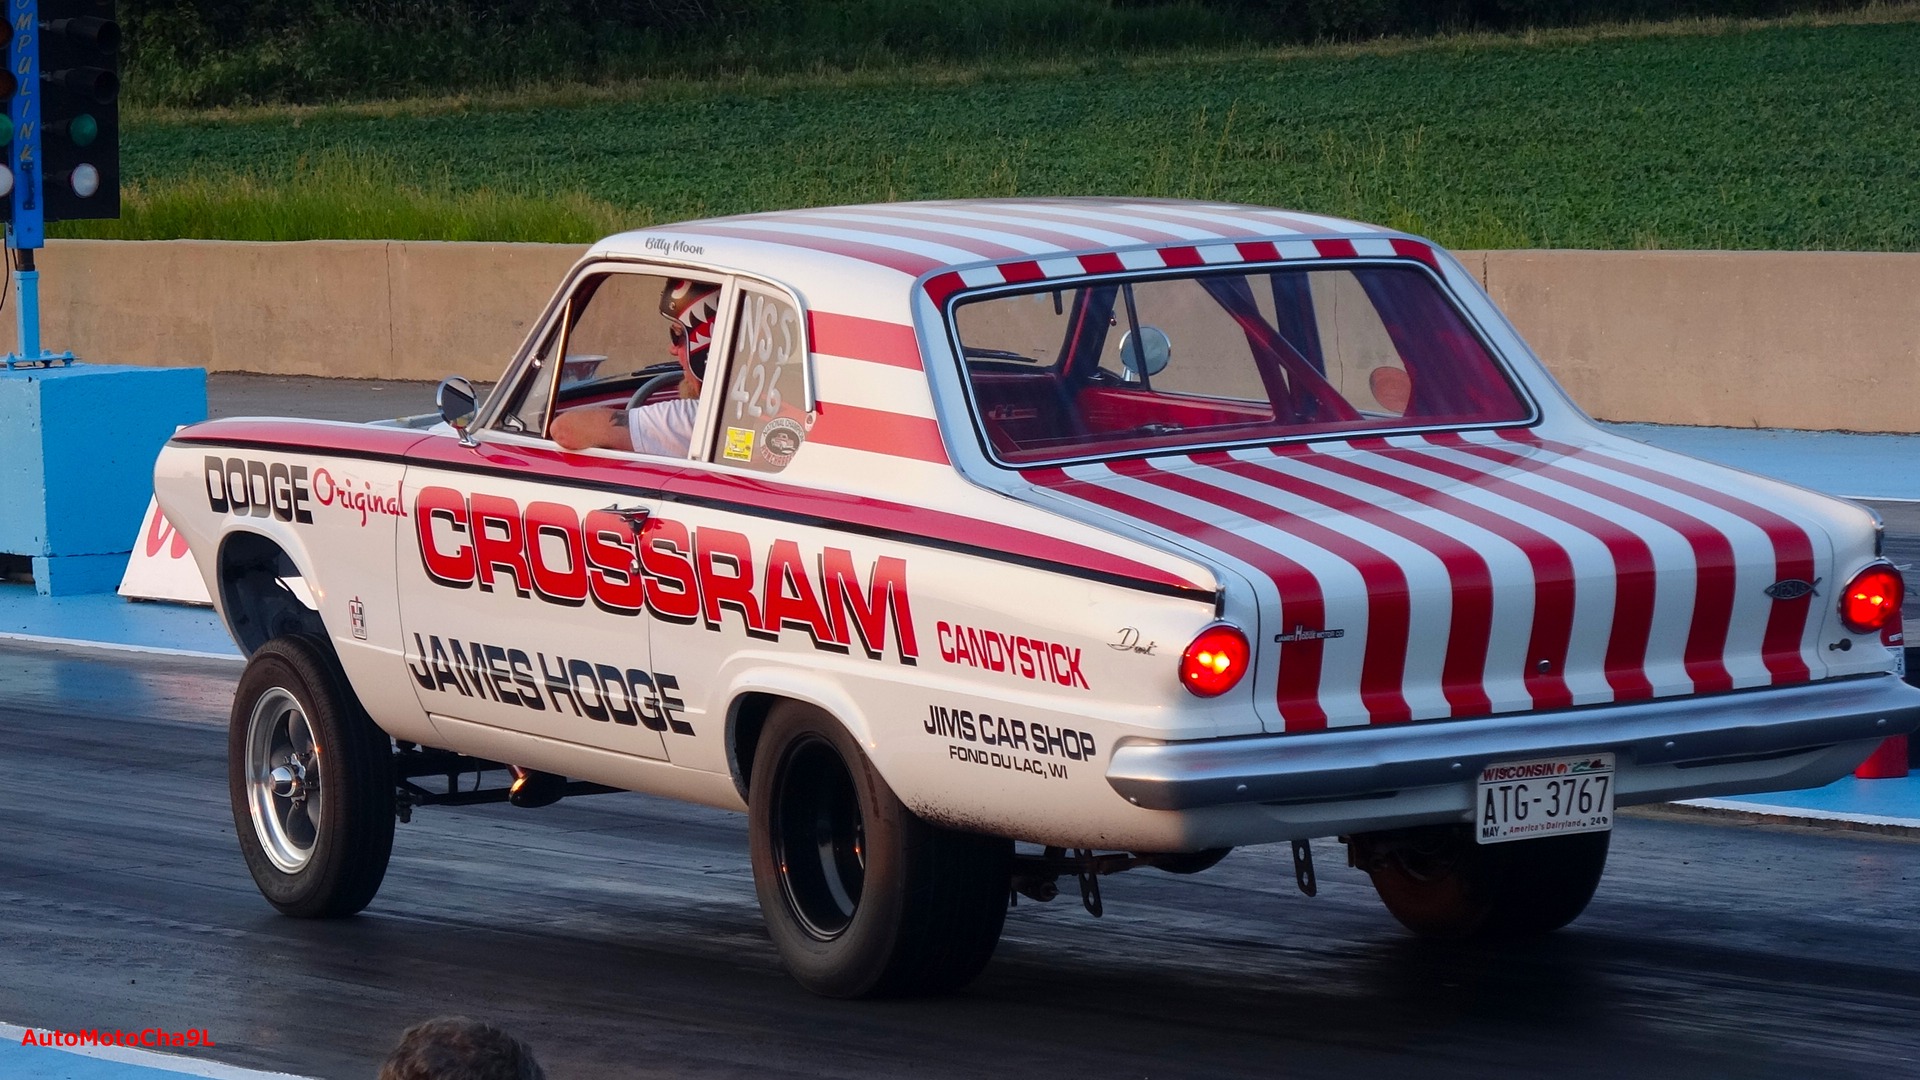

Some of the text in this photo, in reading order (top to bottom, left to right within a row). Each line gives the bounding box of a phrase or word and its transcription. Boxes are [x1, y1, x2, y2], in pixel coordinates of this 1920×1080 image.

[645, 237, 704, 256] Billy Moon
[739, 295, 797, 365] NSS
[731, 364, 781, 420] 426
[204, 455, 314, 525] DODGE
[313, 467, 408, 527] Original
[414, 485, 919, 667] CROSSRAM
[936, 620, 1090, 690] CANDYSTICK
[408, 632, 696, 737] JAMES HODGE
[924, 704, 1096, 762] JIMS CAR SHOP
[949, 745, 1068, 779] FOND DU LAC, WI
[1483, 763, 1556, 782] WISCONSIN
[1483, 776, 1609, 826] ATG-3767
[1509, 819, 1581, 834] America's Dairyland
[1482, 826, 1500, 838] MAY
